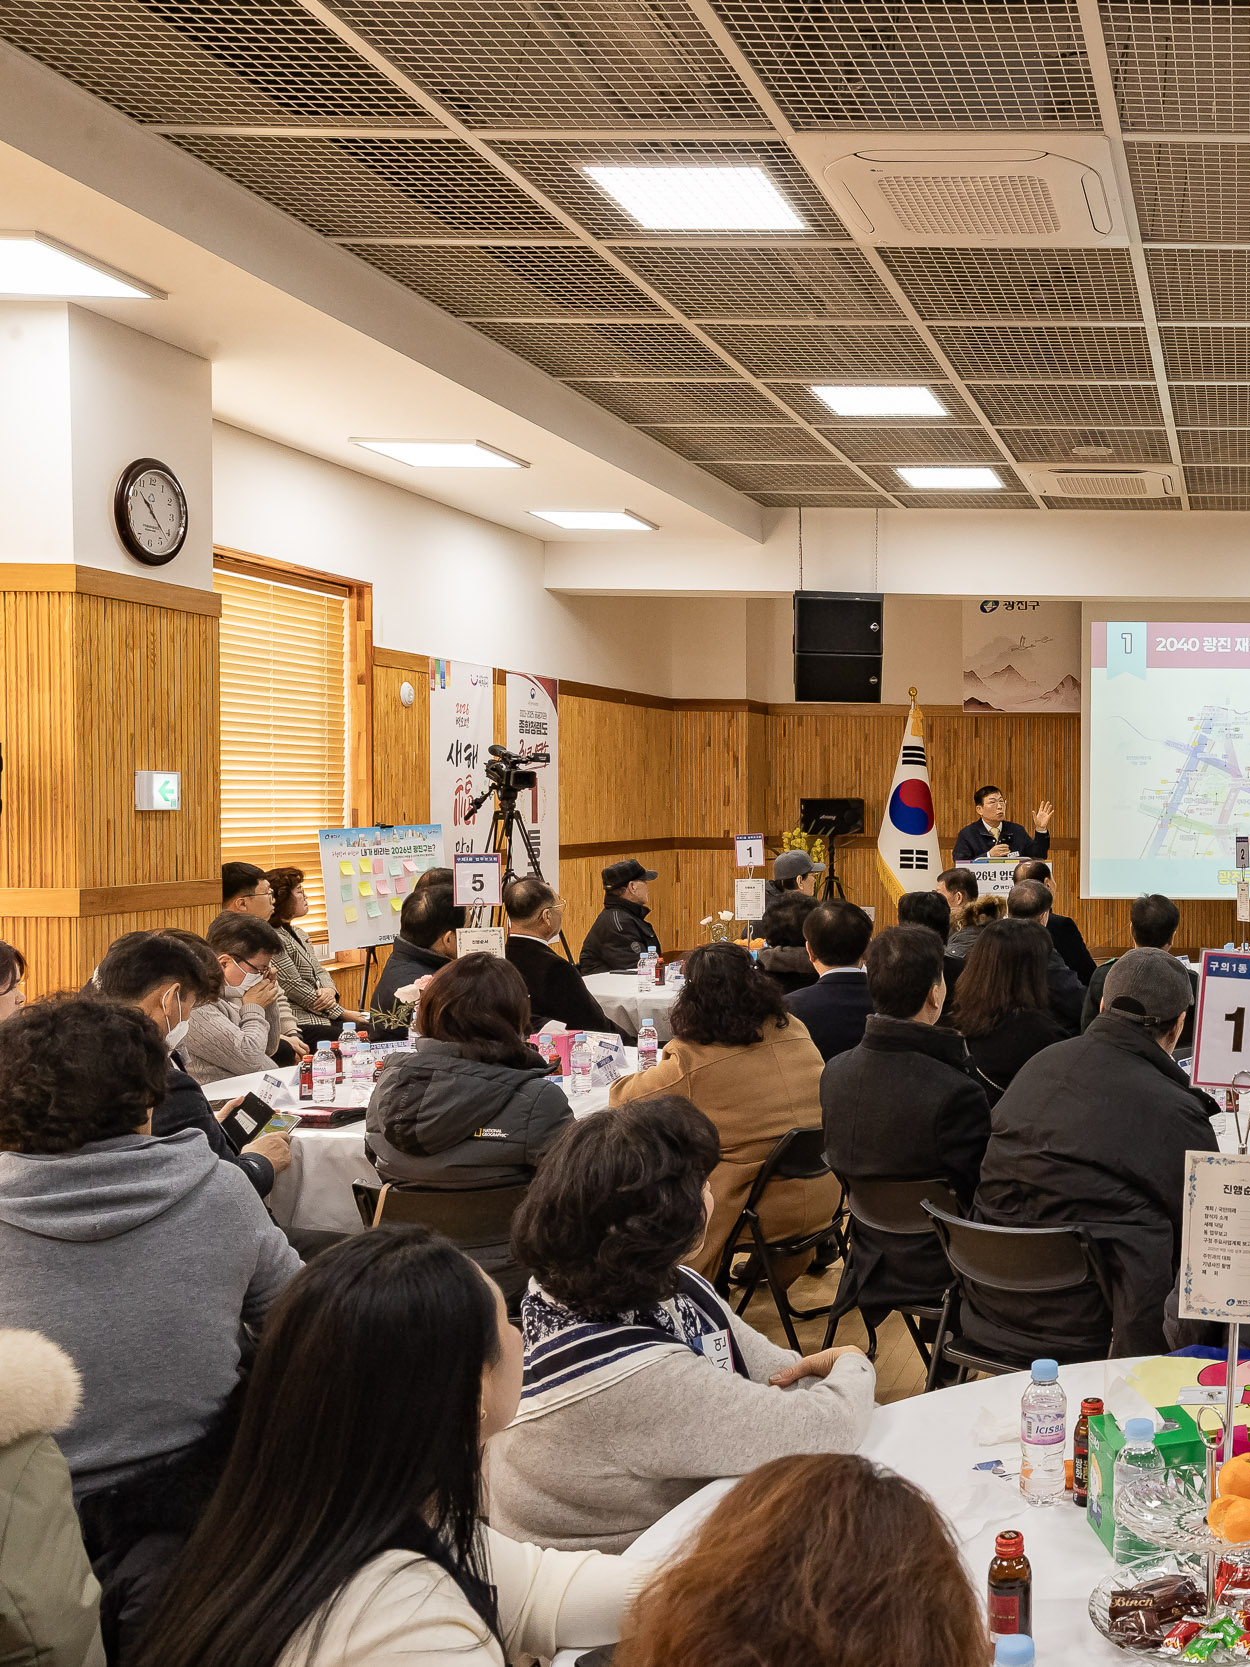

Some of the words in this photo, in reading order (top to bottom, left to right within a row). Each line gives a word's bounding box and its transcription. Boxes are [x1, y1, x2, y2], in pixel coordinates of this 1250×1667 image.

[1003, 600, 1040, 610] 광진구
[1121, 633, 1132, 654] 1
[1156, 637, 1200, 652] 2040
[1203, 637, 1231, 653] 광진
[519, 720, 548, 735] 종합청렴도
[446, 739, 478, 769] 새해
[391, 846, 412, 854] 2026년
[747, 847, 752, 858] 1
[1240, 849, 1245, 860] 2
[472, 874, 484, 891] 5
[1210, 962, 1248, 974] 구의1동
